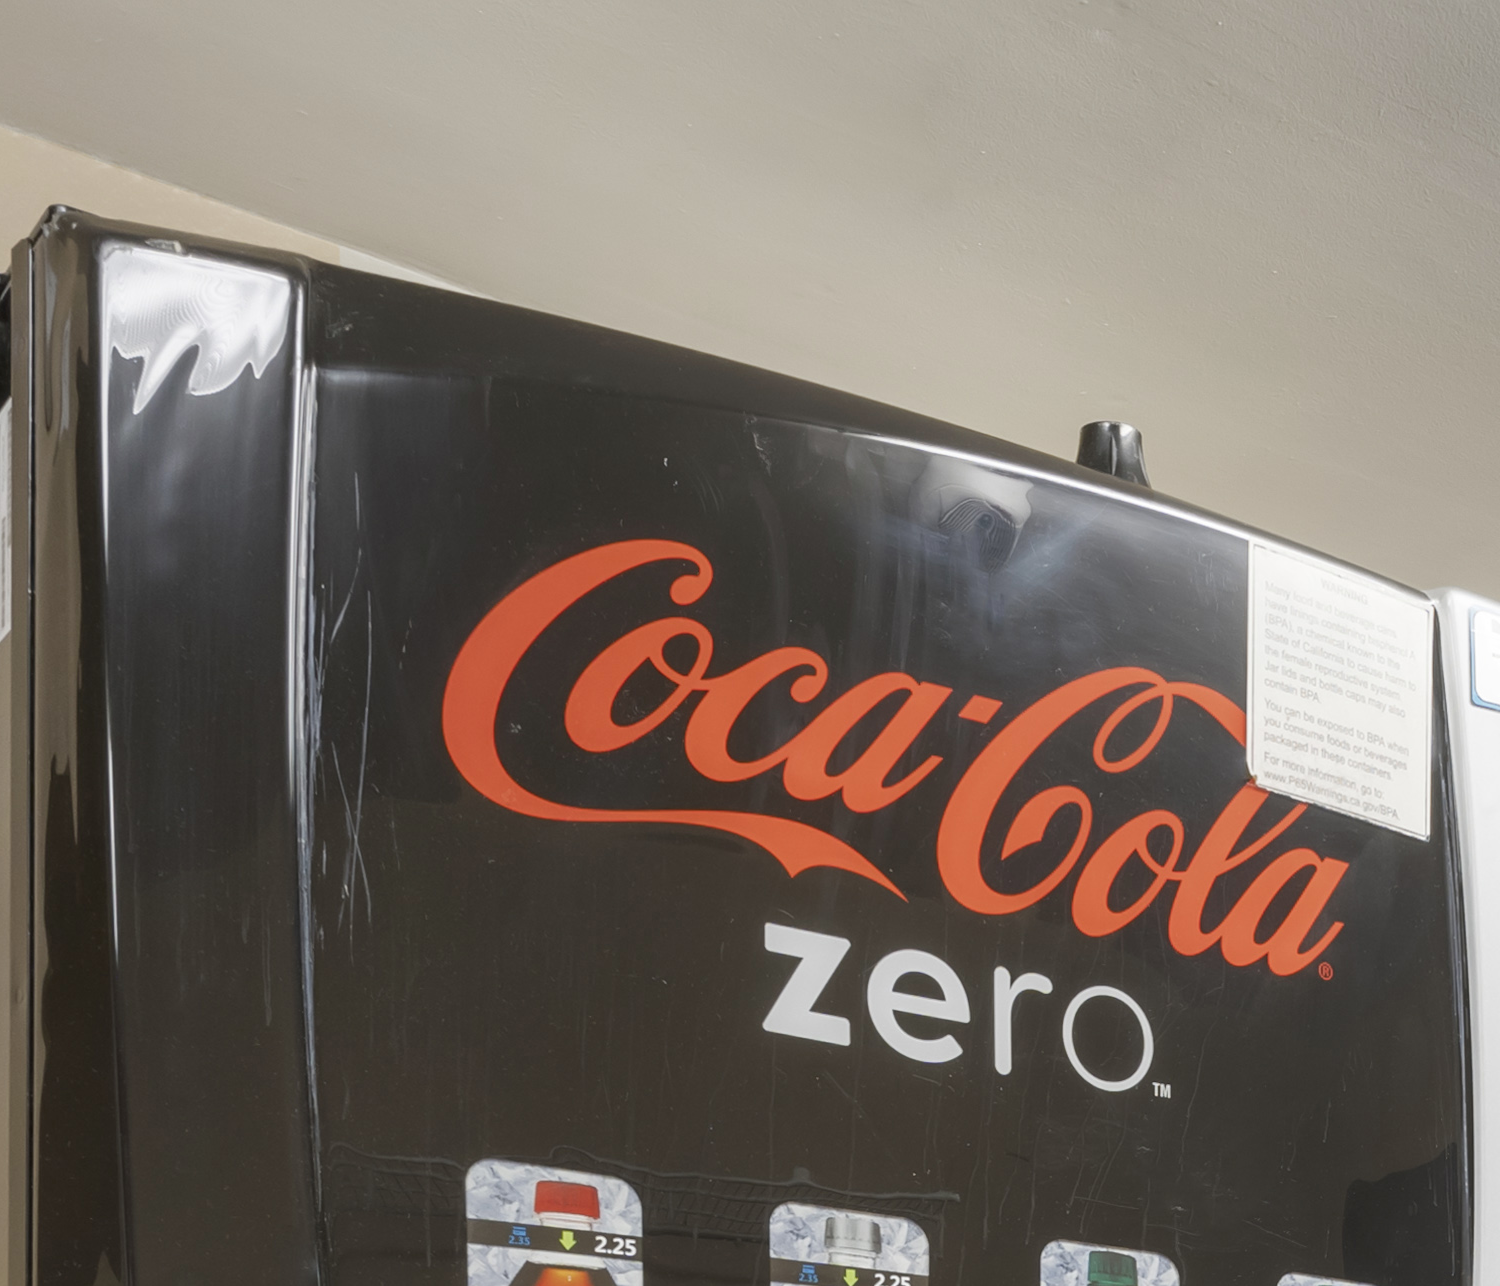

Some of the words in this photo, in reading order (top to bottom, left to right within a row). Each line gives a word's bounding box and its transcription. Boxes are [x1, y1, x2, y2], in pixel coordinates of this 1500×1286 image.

[1319, 579, 1368, 604] WARNING
[1263, 698, 1282, 714] You
[1284, 706, 1301, 720] can
[1303, 711, 1314, 724] be
[1316, 715, 1354, 739] exposed
[1355, 729, 1365, 740] to
[1366, 732, 1386, 748] BPA
[1387, 740, 1409, 756] when
[1263, 715, 1281, 730] you
[1283, 720, 1324, 742] consume
[1326, 734, 1350, 750] foods
[1352, 744, 1362, 755] or
[1363, 747, 1407, 772] beverages
[441, 539, 1345, 976] Coca-Cola
[1263, 730, 1308, 755] packaged
[1310, 745, 1318, 756] in
[1320, 748, 1345, 765] these
[1346, 757, 1394, 780] containers.
[1263, 751, 1279, 766] For
[1281, 758, 1305, 774] more
[1307, 765, 1358, 792] information,
[1359, 783, 1372, 798] go
[1373, 787, 1384, 799] to:
[762, 922, 1155, 1093] zero
[508, 1235, 531, 1247] 2.35
[594, 1235, 638, 1257] 2.25
